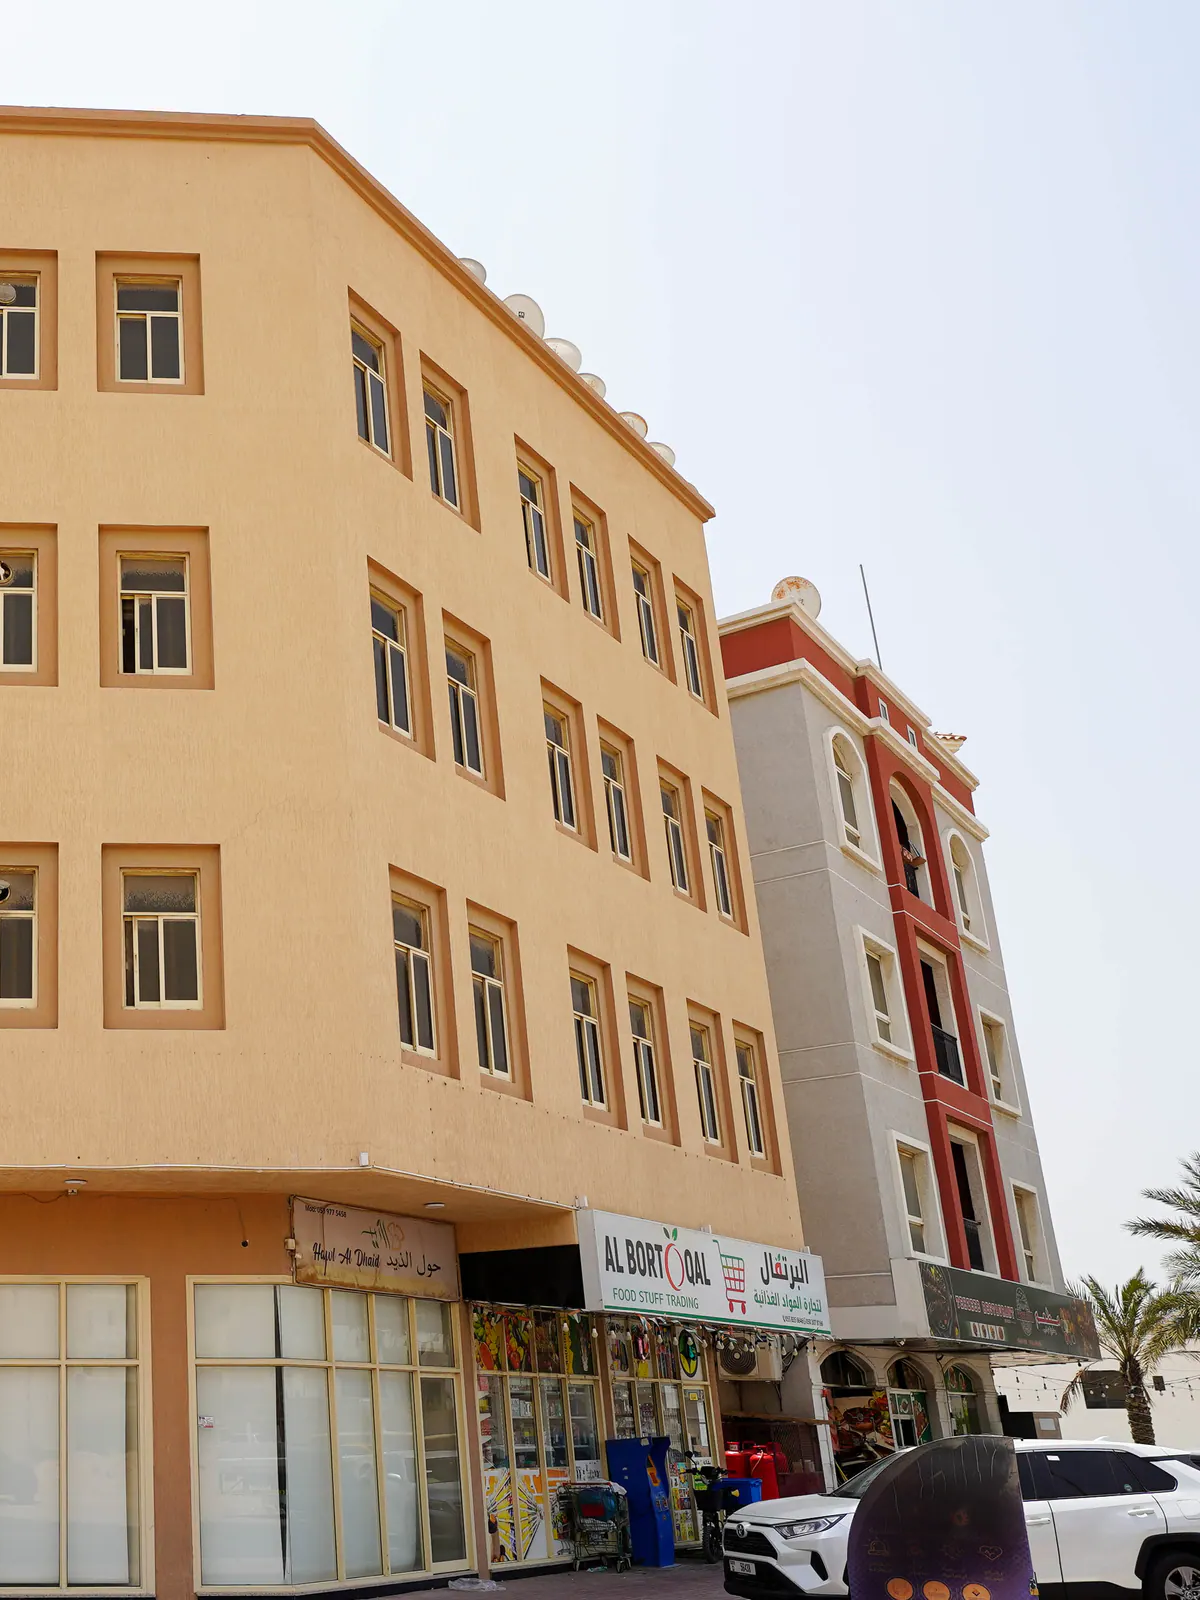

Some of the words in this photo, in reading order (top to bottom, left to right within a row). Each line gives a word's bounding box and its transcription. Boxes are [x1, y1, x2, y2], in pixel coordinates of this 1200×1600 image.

[338, 1247, 351, 1265] Al
[354, 1248, 380, 1268] Dhaid
[386, 1252, 412, 1271] الذيد
[416, 1254, 441, 1278] حول
[605, 1235, 624, 1273] AL
[625, 1239, 711, 1291] BORTOQAL
[760, 1252, 809, 1290] البرتقال
[613, 1288, 636, 1301] FOOD
[639, 1291, 663, 1304] STUFF
[666, 1294, 699, 1309] TRADING
[754, 1289, 780, 1308] الغذائية
[782, 1294, 802, 1312] المواد
[804, 1297, 822, 1316] لتجارة
